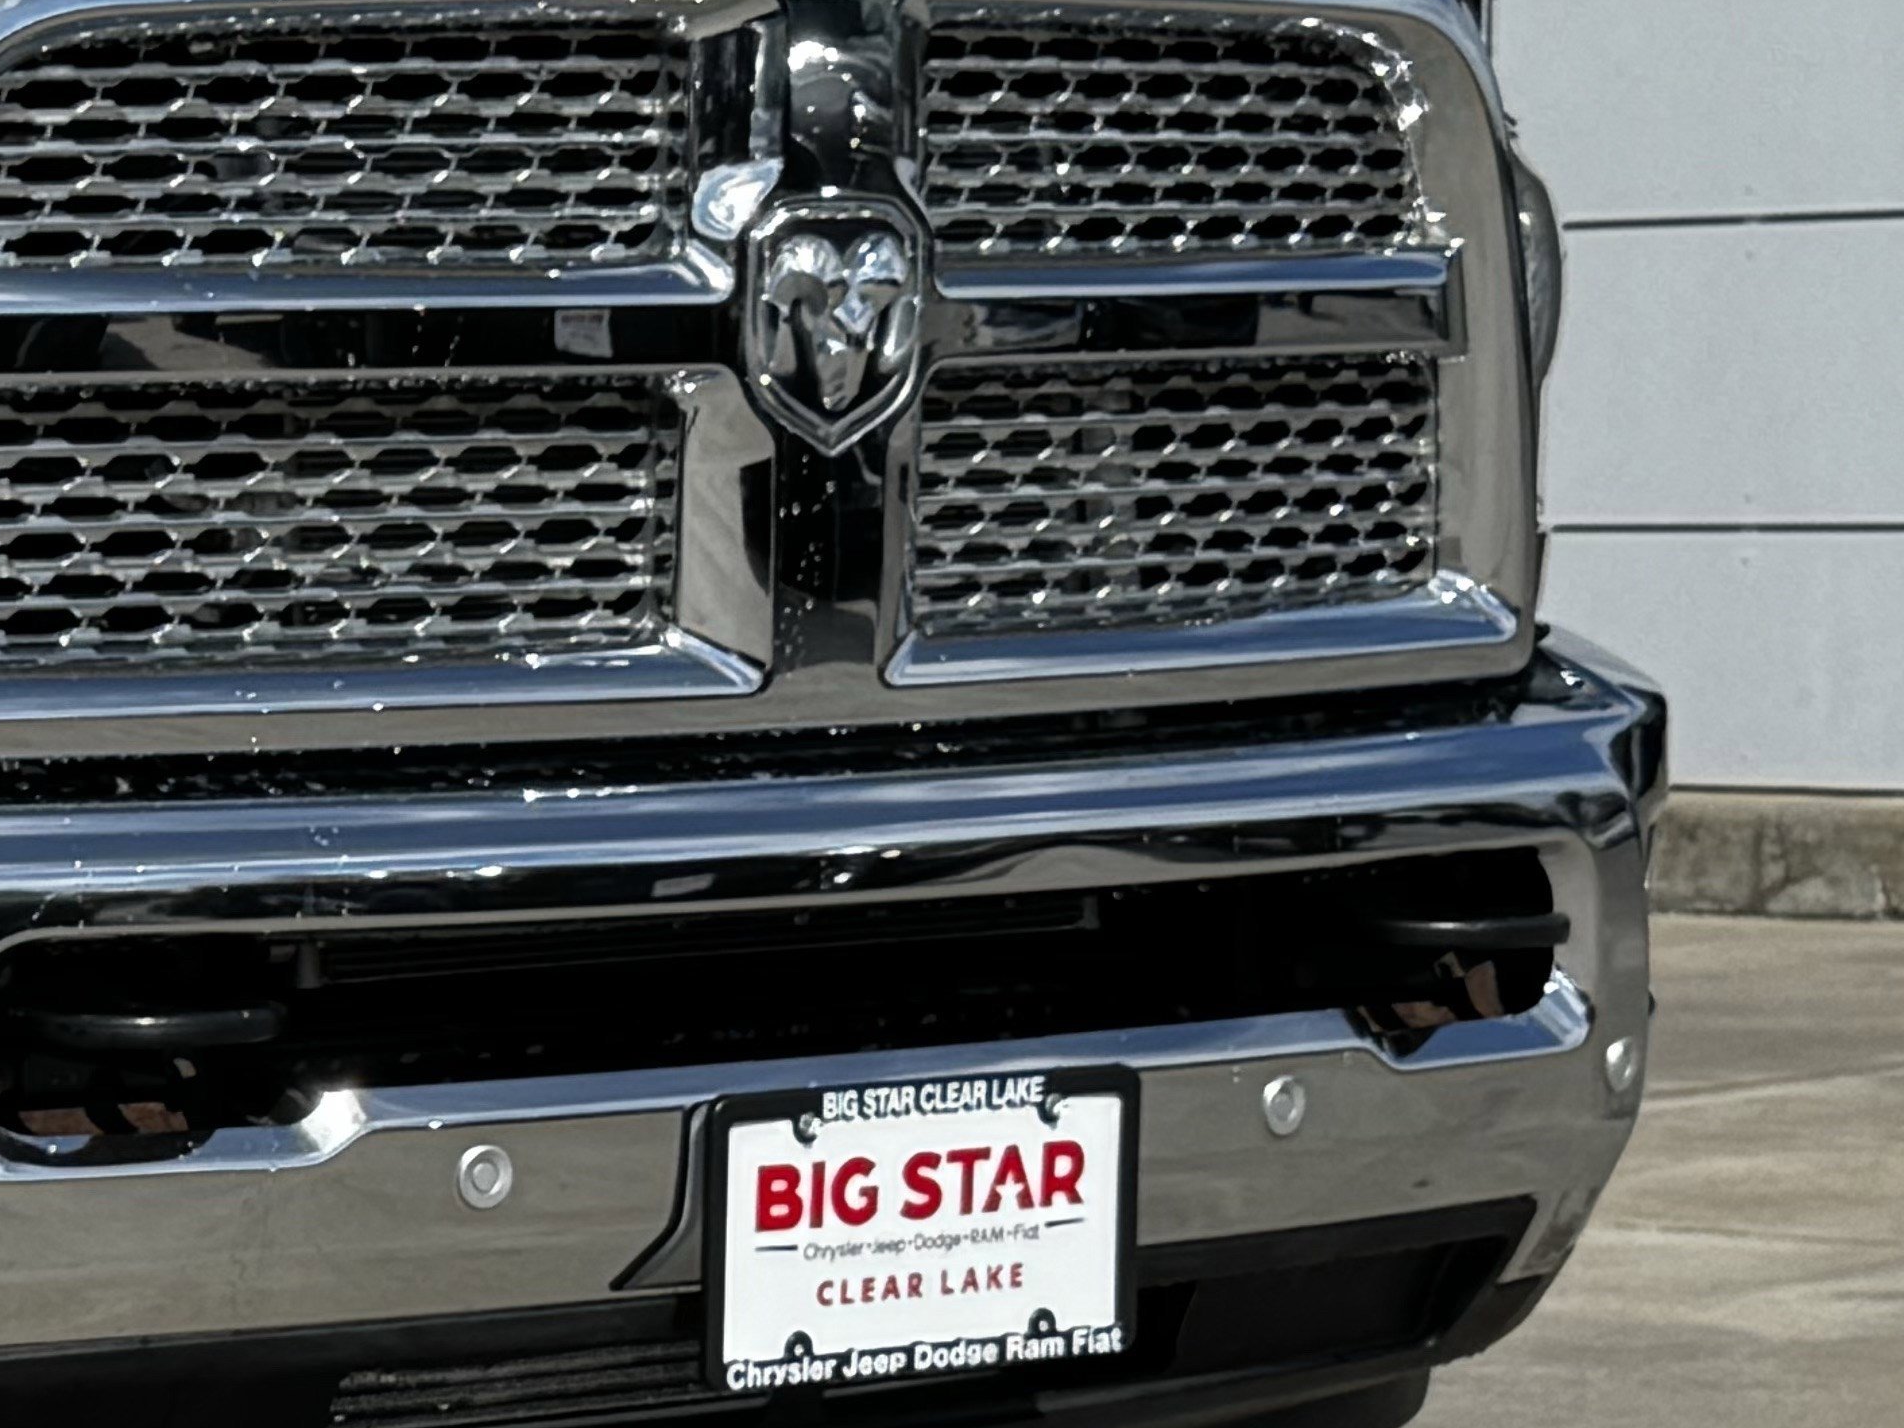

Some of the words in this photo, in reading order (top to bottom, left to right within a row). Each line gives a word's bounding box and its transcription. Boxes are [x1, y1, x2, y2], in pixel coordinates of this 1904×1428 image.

[822, 1089, 859, 1120] BIG
[863, 1084, 916, 1119] STAR
[919, 1079, 987, 1111] CLEAR
[992, 1075, 1045, 1106] LAKE
[754, 1155, 879, 1233] BIG
[899, 1139, 1086, 1221] STAR
[815, 1271, 924, 1308] CLEAR
[940, 1262, 1025, 1295] LAKE
[725, 1355, 834, 1391] Chrysler
[842, 1349, 909, 1381] Jeep
[914, 1339, 998, 1371] Dodge
[1005, 1333, 1066, 1361] Ram
[1071, 1327, 1124, 1356] Fiat
